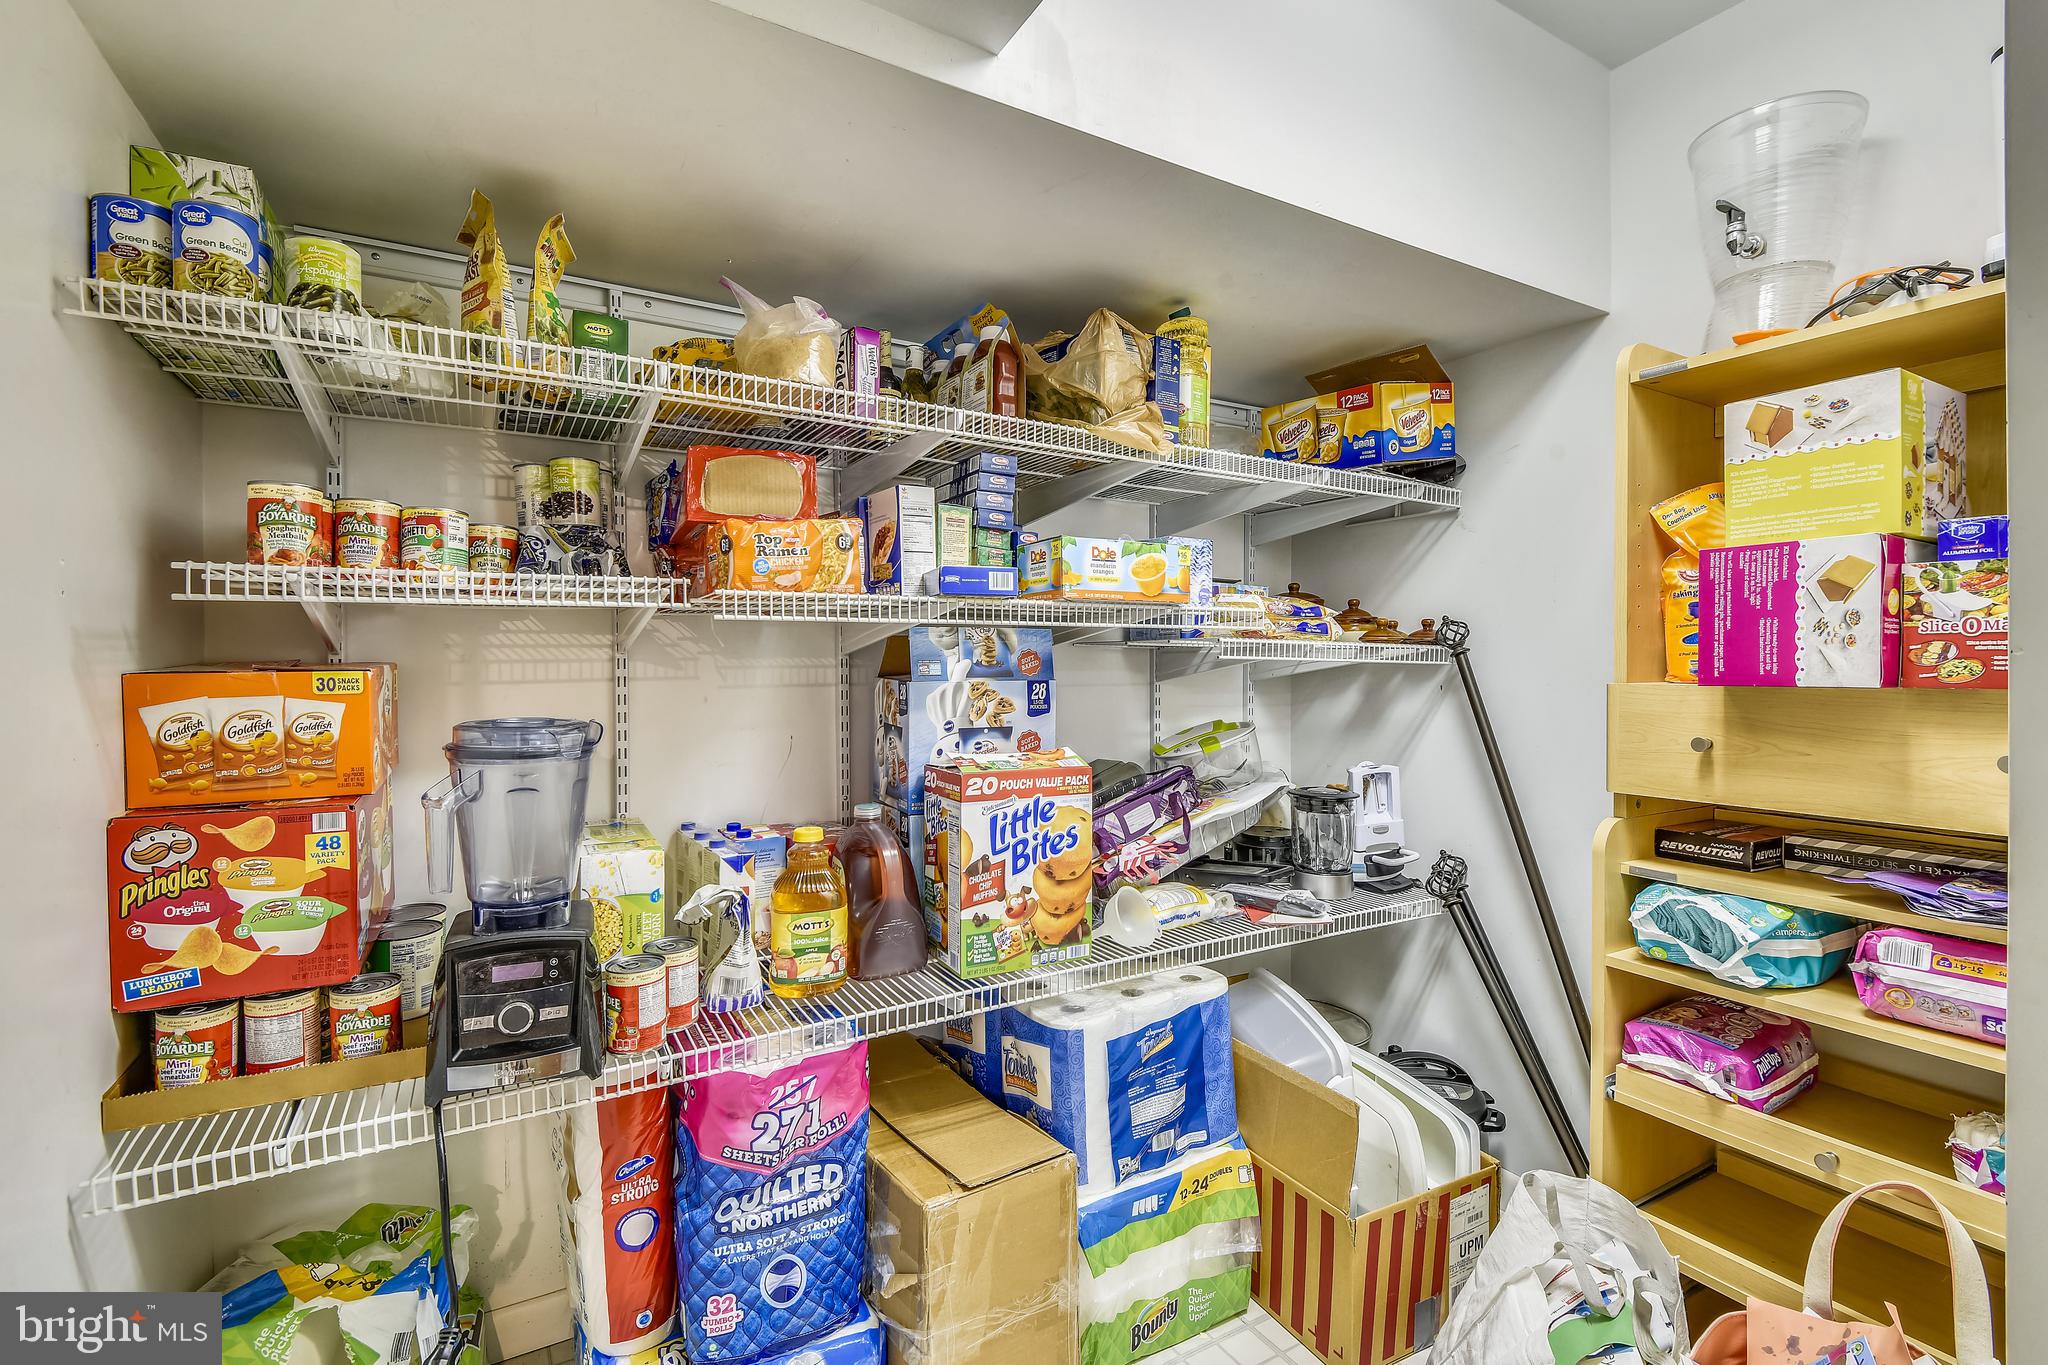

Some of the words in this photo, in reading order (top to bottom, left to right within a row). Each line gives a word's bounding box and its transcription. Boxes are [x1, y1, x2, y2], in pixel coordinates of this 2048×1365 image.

[110, 205, 139, 216] Great
[117, 211, 139, 220] Value
[182, 209, 206, 219] Great
[115, 232, 151, 245] Green
[232, 238, 248, 248] Cut
[186, 236, 216, 248] Green
[219, 239, 248, 257] Beans
[867, 347, 879, 377] Welch's
[1341, 395, 1354, 408] 12
[1353, 391, 1369, 401] PACK
[1432, 389, 1440, 400] 12
[1401, 409, 1425, 430] Velveeta
[1279, 419, 1308, 444] Velveeta
[263, 502, 282, 513] Chef
[258, 511, 316, 528] BOYARDEE
[1667, 510, 1693, 527] Countless
[266, 525, 303, 537] Spaghetti
[268, 532, 308, 542] Meatballs
[338, 523, 388, 539] BOYARDEE
[348, 536, 370, 545] Mini
[754, 533, 782, 547] Top
[470, 547, 511, 559] BOYARDEE
[756, 545, 808, 557] Ramen
[1030, 549, 1047, 563] Dole
[1091, 546, 1117, 559] Dole
[477, 560, 502, 569] Ravioli
[770, 557, 804, 566] CHICKEN
[1673, 589, 1699, 599] Baking
[1921, 620, 1959, 633] Slice
[1021, 655, 1035, 665] SOFT
[1021, 660, 1039, 671] BAKED
[316, 677, 336, 693] 30
[337, 677, 360, 685] SNACK
[900, 684, 907, 700] 28
[1031, 683, 1047, 700] 28
[164, 719, 203, 742] Goldfish
[228, 719, 273, 740] Goldfish
[295, 720, 333, 733] Goldfish
[1021, 736, 1035, 746] SOFT
[1021, 741, 1039, 753] BAKED
[257, 763, 283, 774] Cheddar
[312, 758, 334, 766] Cheddar
[925, 771, 938, 787] 20
[966, 777, 999, 796] 20
[1000, 778, 1033, 791] POUCH
[1036, 777, 1062, 788] VALUE
[1065, 775, 1089, 786] PACK
[927, 800, 942, 823] Little
[901, 817, 908, 833] 28
[931, 816, 948, 837] Bites
[989, 796, 1056, 857] Little
[315, 836, 342, 851] 48
[1011, 824, 1079, 876] Bites
[1660, 840, 1744, 859] REVOLUTION
[317, 857, 336, 865] PACK
[1755, 848, 1781, 861] REVOLU
[1857, 856, 1864, 865] 2
[1865, 858, 1879, 867] OF
[1881, 860, 1899, 870] SET
[227, 868, 273, 879] Pringles
[968, 868, 1002, 885] CHOCOLATE
[121, 866, 210, 918] Pringles
[979, 881, 992, 891] CHIP
[973, 888, 998, 902] MUFFINS
[163, 903, 210, 917] Original
[251, 908, 294, 923] Pringles
[131, 926, 142, 934] 24
[792, 920, 830, 931] MOTT'S
[1953, 963, 1984, 974] 3T-4T
[129, 971, 193, 990] LUNCHBOX
[140, 980, 184, 996] READY!
[336, 1015, 392, 1033] BOYARDEE
[340, 1014, 354, 1022] Chef
[350, 1033, 374, 1044] Mini
[1136, 1030, 1173, 1060] Towels
[156, 1040, 214, 1056] BOYARDEE
[342, 1043, 358, 1051] beef
[348, 1045, 381, 1054] meatballs
[166, 1059, 191, 1069] Mini
[175, 1066, 202, 1074] ravioli
[1002, 1046, 1038, 1085] Towels
[163, 1072, 199, 1081] meatballs
[752, 1098, 821, 1152] 271
[723, 1147, 780, 1167] SHEETS
[782, 1138, 804, 1159] PER
[809, 1114, 848, 1146] ROLL!
[618, 1158, 646, 1177] Charmin
[1209, 1166, 1233, 1180] DOUBLES
[621, 1174, 651, 1193] ULTRA
[611, 1179, 659, 1205] STRONG
[715, 1163, 844, 1223] QUILTED
[731, 1193, 832, 1233] NORTHERN
[714, 1241, 753, 1257] ULTRA
[756, 1233, 787, 1249] SOFT
[789, 1231, 795, 1239] &
[800, 1214, 846, 1235] STRONG
[728, 1254, 756, 1264] LAYERS
[757, 1249, 776, 1258] THAT
[794, 1236, 809, 1245] AND
[810, 1232, 829, 1241] HOLD
[1459, 1235, 1484, 1258] UPM
[1188, 1287, 1203, 1296] The
[1188, 1291, 1216, 1304] Quicker
[709, 1296, 734, 1317] 32
[1188, 1302, 1211, 1313] Picker
[703, 1313, 742, 1327] JUMBO+
[1189, 1309, 1211, 1322] Upper
[709, 1323, 733, 1335] ROLLS
[1131, 1298, 1179, 1353] Bounty
